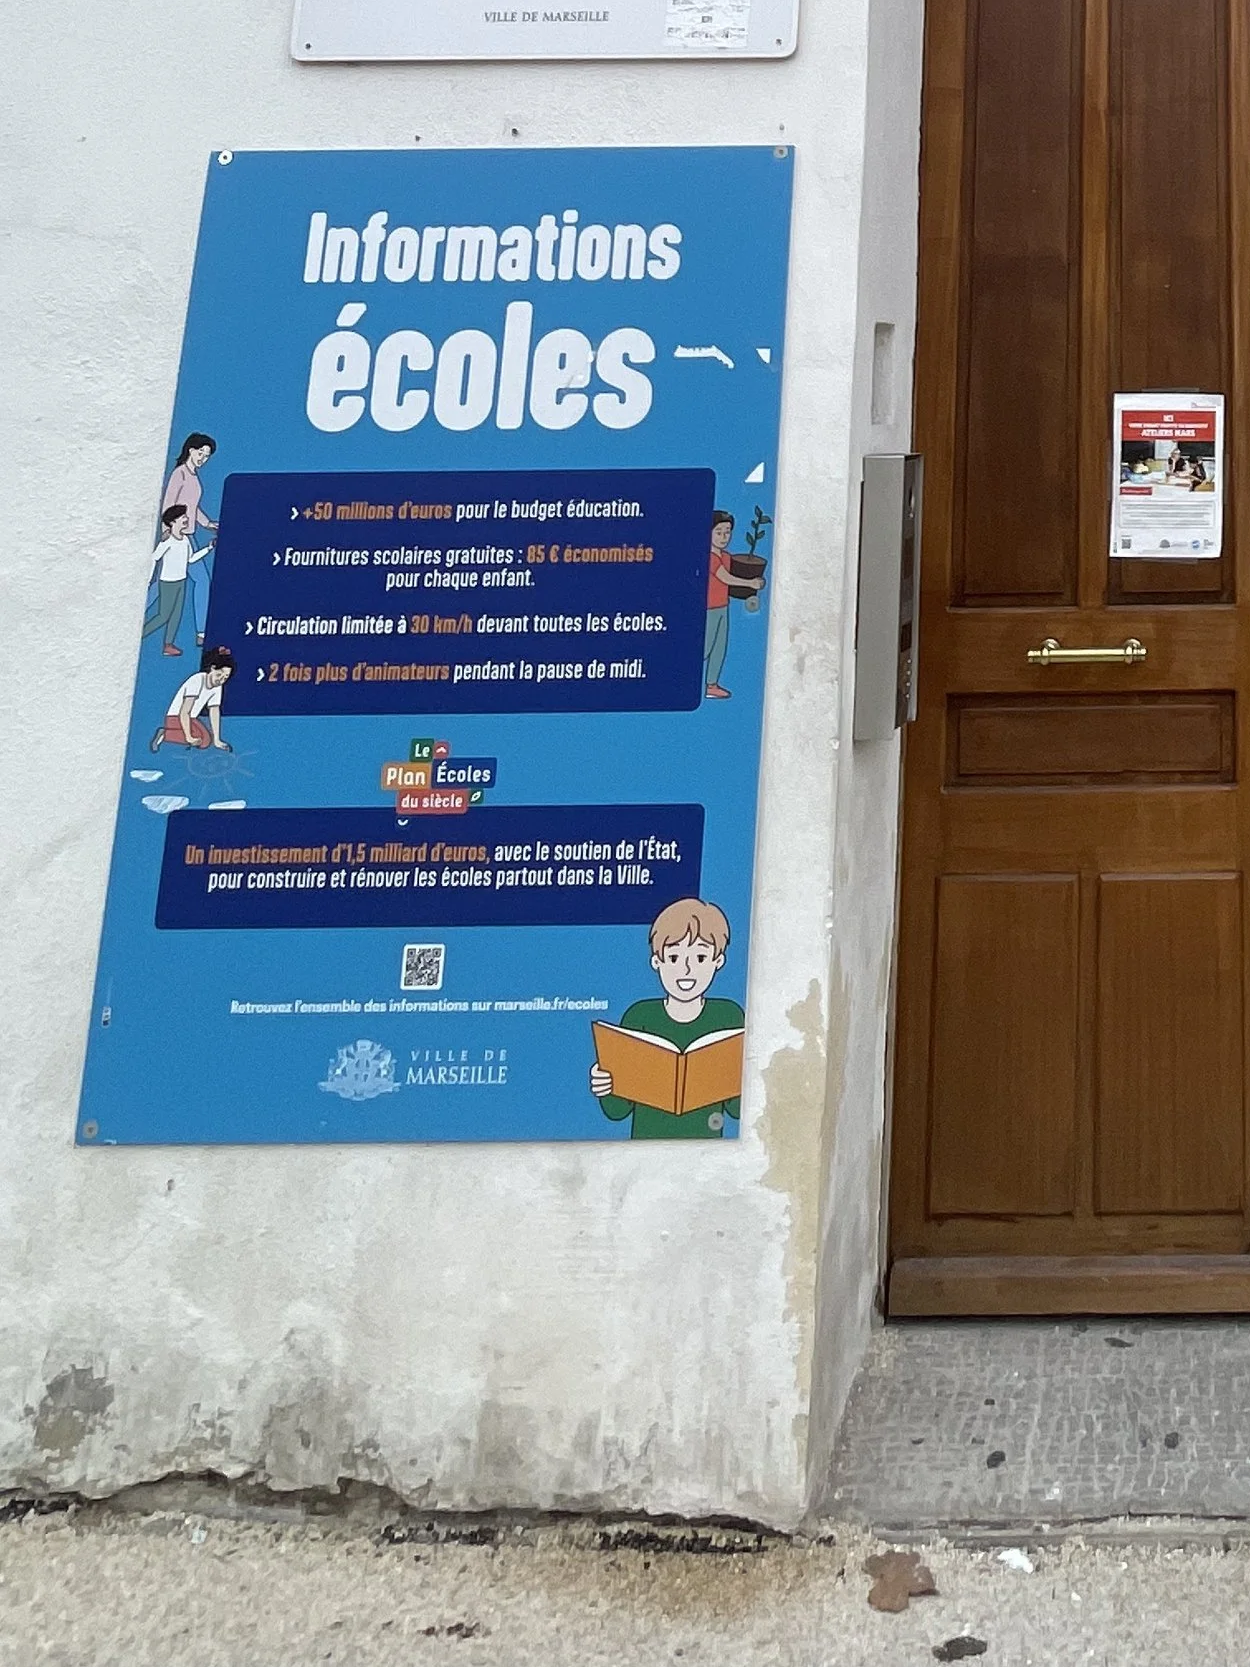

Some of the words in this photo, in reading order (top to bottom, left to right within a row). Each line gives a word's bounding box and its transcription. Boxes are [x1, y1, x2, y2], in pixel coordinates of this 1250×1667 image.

[484, 11, 517, 23] VILLE
[521, 11, 538, 22] DE
[542, 10, 610, 23] MARSEILLE
[303, 209, 683, 283] Informations
[306, 300, 656, 432] écoles
[303, 502, 333, 520] +50
[336, 501, 394, 520] millions
[398, 500, 453, 520] d'euros
[456, 502, 490, 522] pour
[493, 500, 507, 519] le
[511, 499, 563, 522] budget
[567, 498, 645, 518] éducation.
[284, 547, 369, 566] Fournitures
[373, 545, 441, 565] scolaires
[445, 545, 514, 567] gratuites
[526, 545, 545, 564] 85
[549, 544, 560, 563] €
[563, 543, 654, 563] économisés
[385, 571, 419, 592] pour
[423, 569, 478, 590] chaque
[482, 568, 535, 588] enfant.
[257, 615, 338, 635] Circulation
[341, 615, 393, 634] limitée
[397, 615, 407, 634] à
[410, 615, 429, 634] 30
[434, 613, 473, 634] km/h
[476, 614, 529, 633] devant
[533, 614, 582, 633] toutes
[586, 612, 608, 632] les
[613, 612, 667, 631] écoles.
[268, 663, 279, 682] 2
[283, 662, 312, 681] fois
[315, 662, 348, 684] plus
[352, 661, 450, 681] d'animateurs
[453, 660, 515, 683] pendant
[519, 660, 533, 680] la
[537, 663, 583, 682] pause
[587, 659, 606, 678] de
[609, 658, 646, 678] midi.
[415, 743, 430, 757] Le
[386, 767, 425, 786] Plan
[436, 761, 491, 783] Écoles
[401, 793, 418, 808] du
[422, 793, 463, 808] siècle
[184, 844, 204, 864] Un
[208, 844, 328, 864] investissement
[369, 842, 427, 863] milliard
[431, 842, 490, 864] d'euros,
[494, 844, 531, 862] avec
[535, 841, 549, 861] le
[554, 840, 612, 861] soutien
[615, 839, 634, 860] de
[638, 836, 681, 862] l'État,
[208, 872, 243, 893] pour
[247, 868, 326, 889] construire
[330, 868, 346, 888] et
[350, 867, 411, 888] rénover
[414, 867, 437, 887] les
[441, 866, 491, 887] écoles
[496, 866, 553, 890] partout
[557, 865, 594, 886] dans
[598, 865, 612, 885] la
[617, 864, 654, 885] Ville.
[230, 1000, 293, 1014] Retrouvez
[294, 999, 362, 1013] l'ensemble
[364, 998, 386, 1012] des
[389, 998, 469, 1013] informations
[472, 1000, 492, 1011] sur
[494, 997, 608, 1011] marseille.fr/ecoles
[411, 1049, 468, 1062] VILLE
[484, 1049, 507, 1062] DE
[405, 1065, 507, 1085] MARSEILLE
